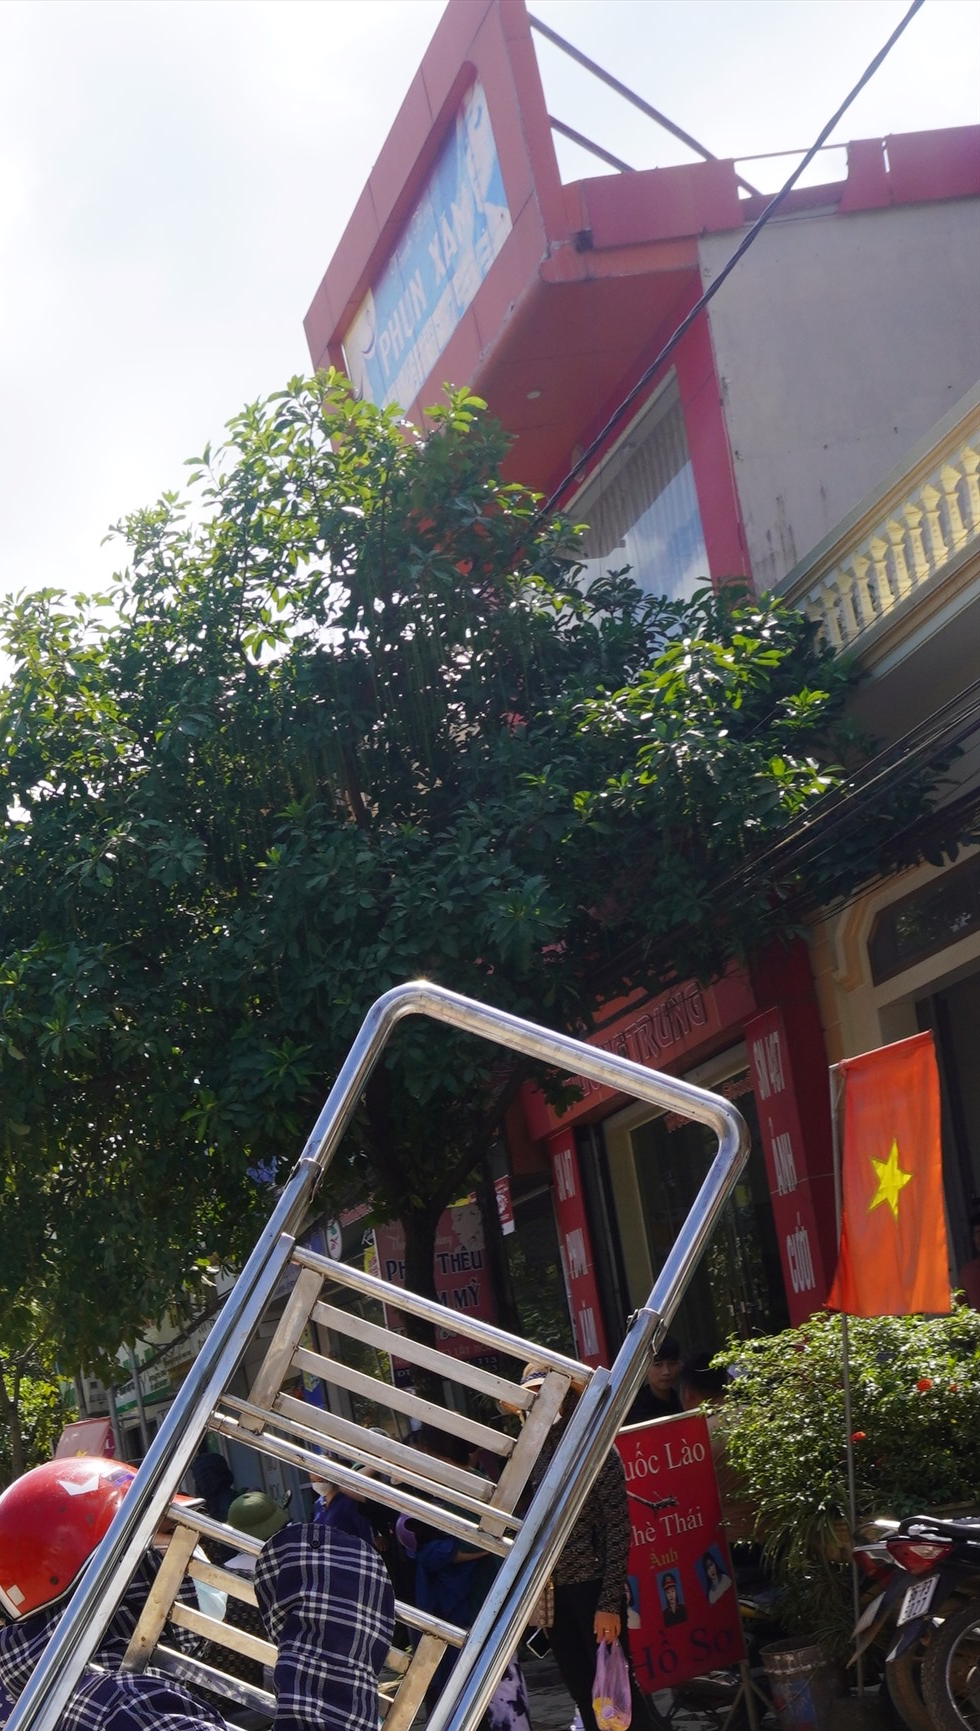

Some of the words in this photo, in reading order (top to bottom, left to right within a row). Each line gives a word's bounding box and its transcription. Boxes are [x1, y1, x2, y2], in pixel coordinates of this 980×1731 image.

[378, 267, 428, 377] PHUN
[625, 981, 709, 1064] TRUNG
[436, 1246, 484, 1275] THÊU
[623, 1441, 660, 1483] uốc
[663, 1439, 706, 1471] Lào
[630, 1521, 657, 1547] hè
[659, 1507, 705, 1538] Thái
